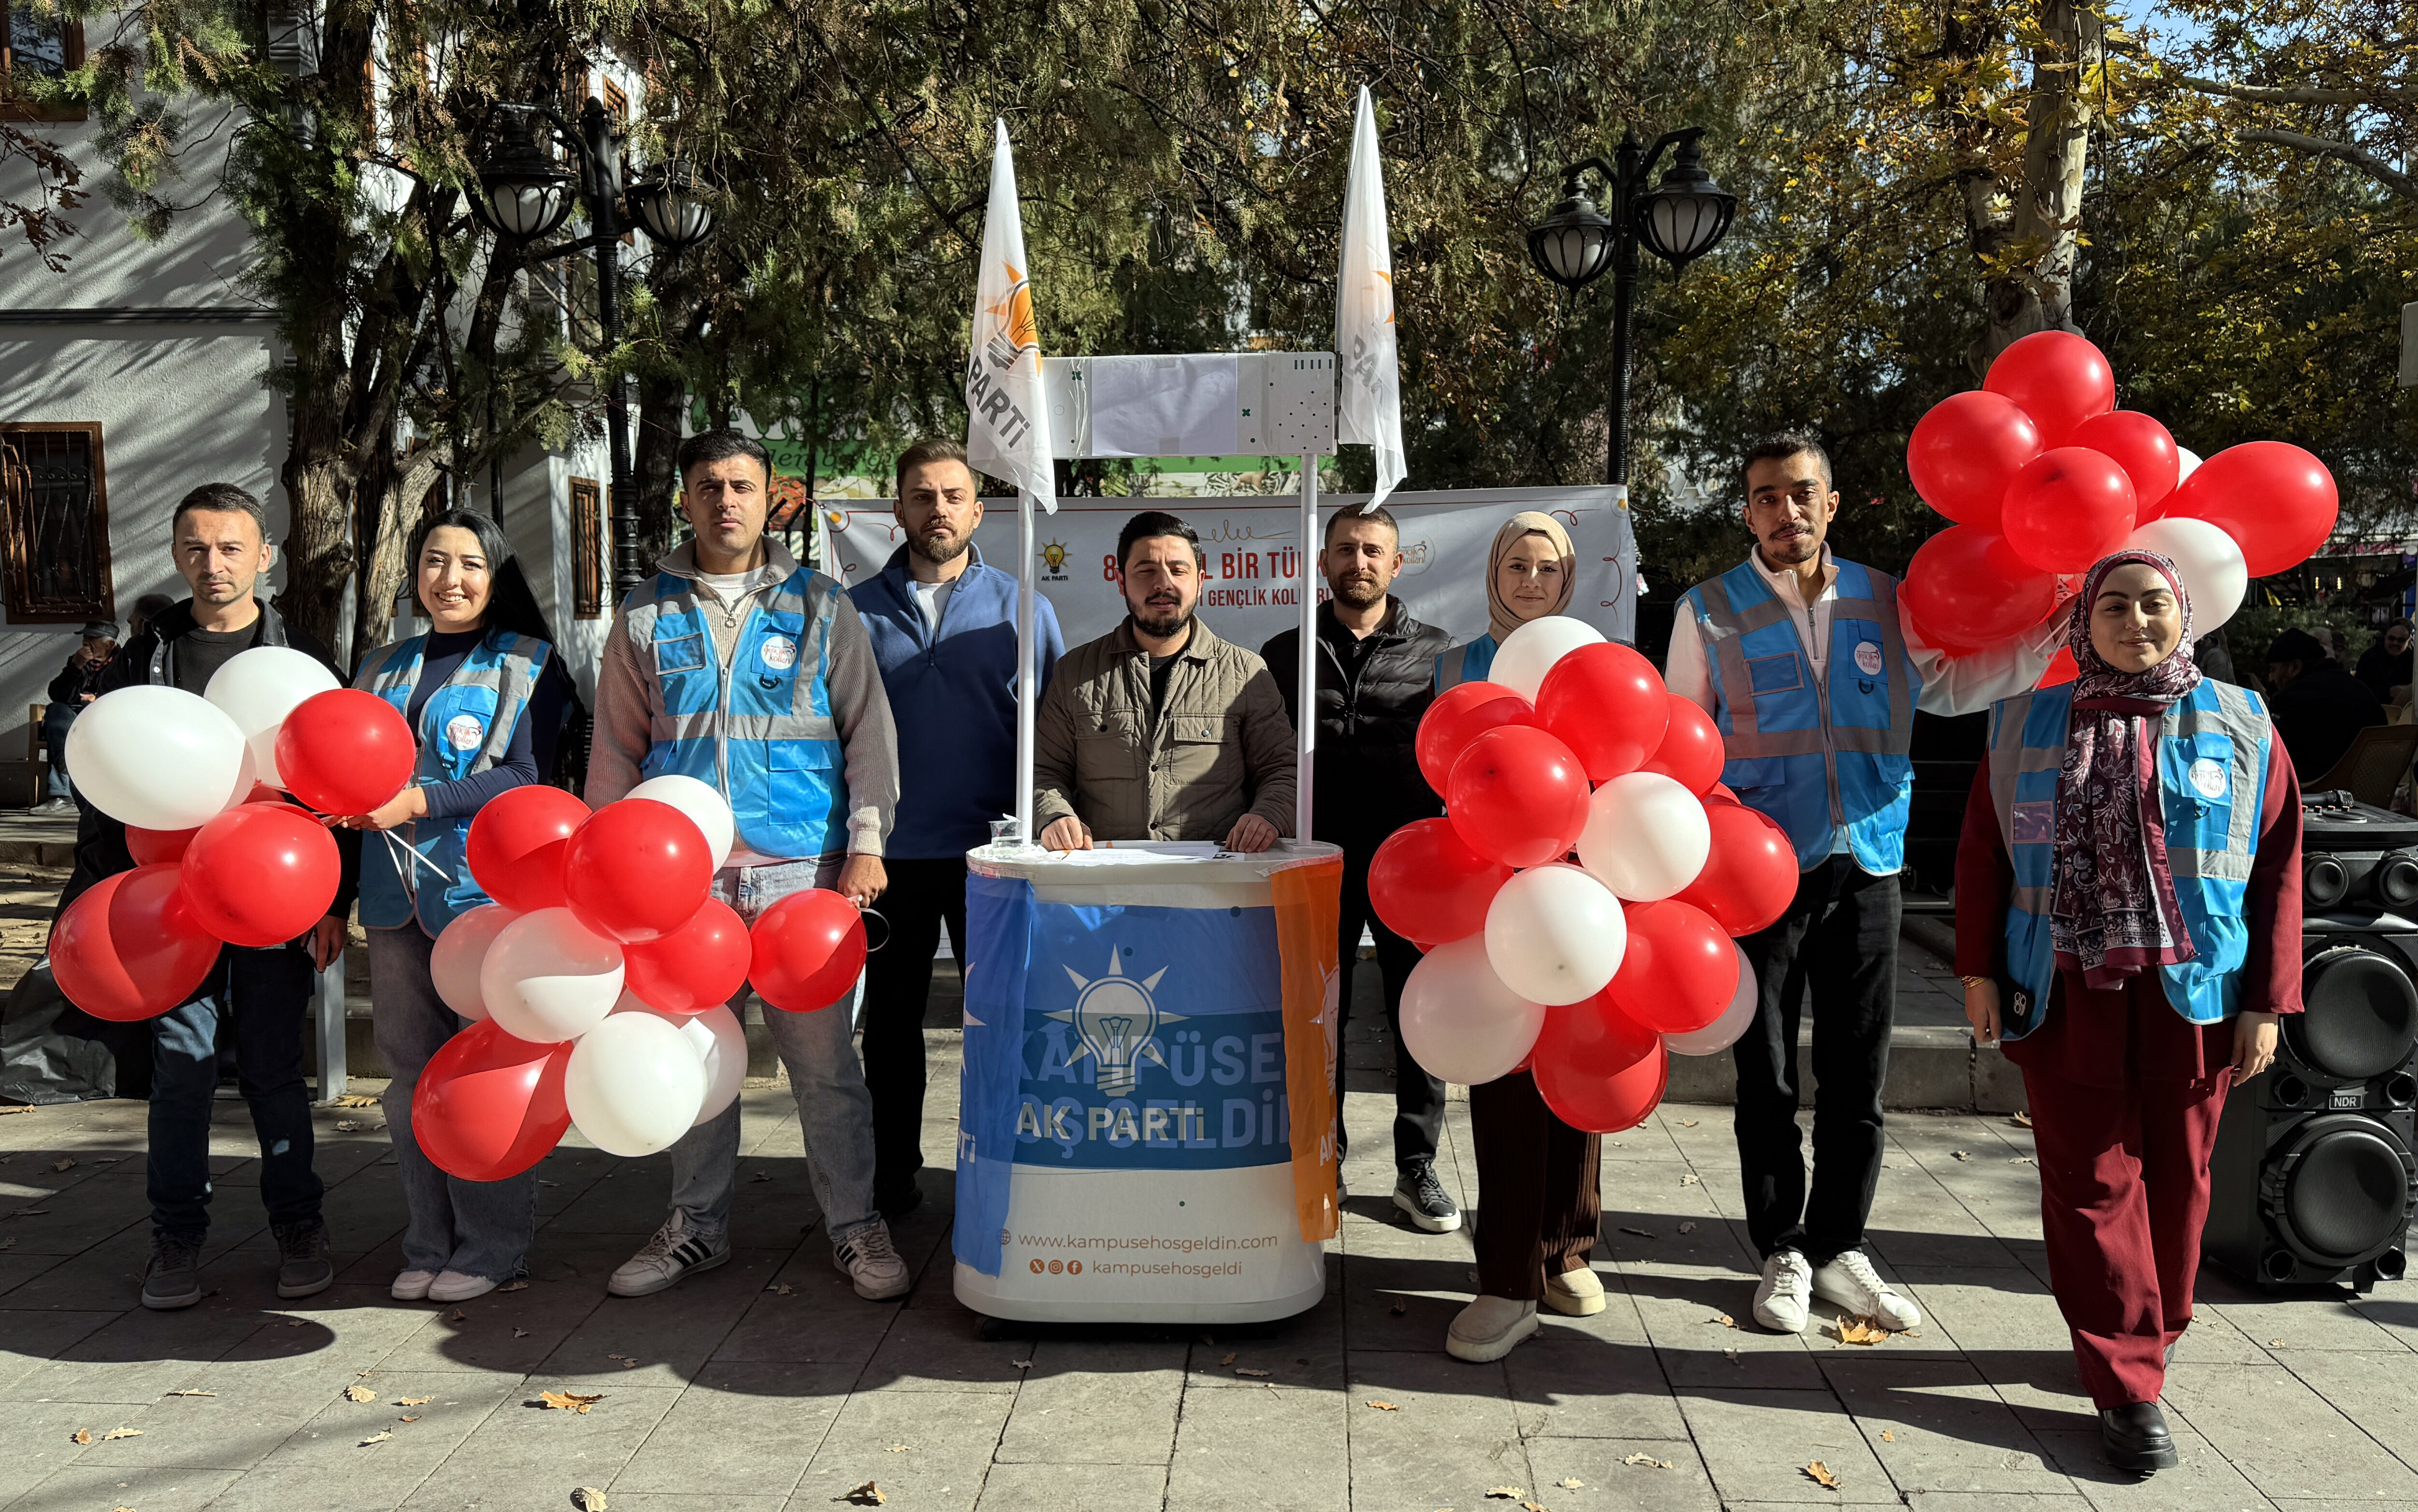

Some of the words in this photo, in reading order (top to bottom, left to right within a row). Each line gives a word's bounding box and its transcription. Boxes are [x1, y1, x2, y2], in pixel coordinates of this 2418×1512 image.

[1222, 547, 1259, 579] BİR
[1208, 585, 1267, 609] GENÇLİK
[2334, 1096, 2357, 1107] NDR
[1017, 1102, 1071, 1140] AK
[1018, 1234, 1278, 1253] www.kampusehosgeldin.com
[1092, 1260, 1242, 1278] kampusehosgeldi
